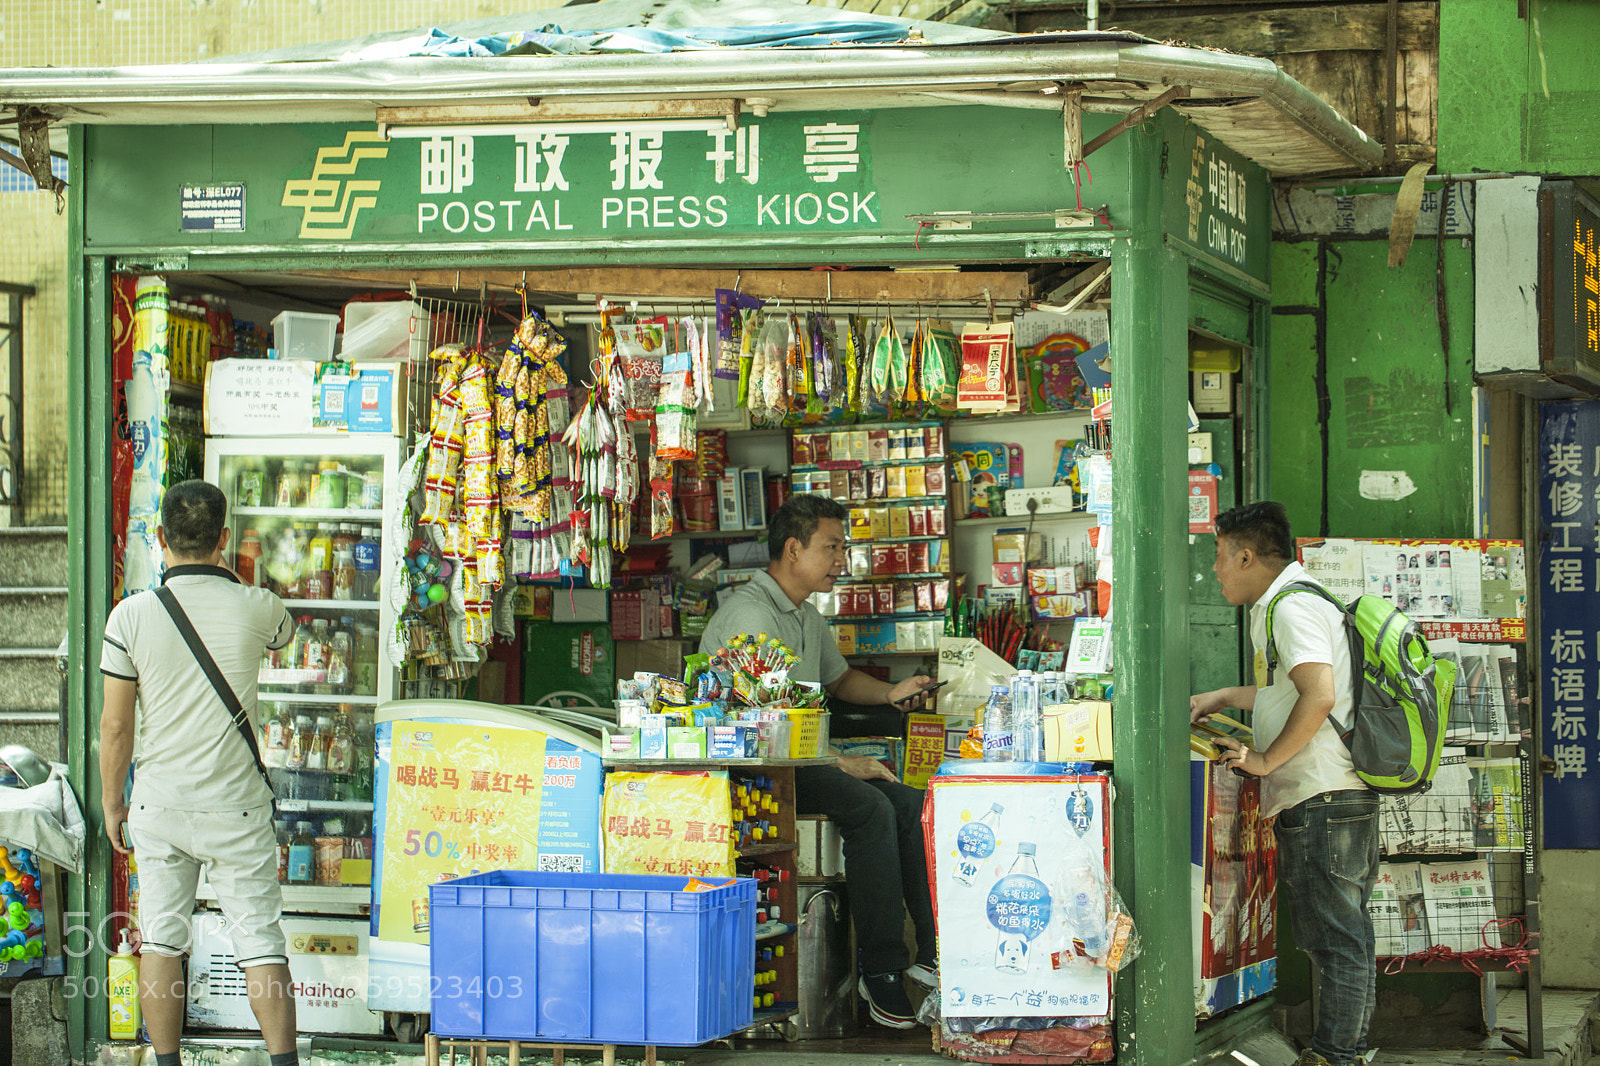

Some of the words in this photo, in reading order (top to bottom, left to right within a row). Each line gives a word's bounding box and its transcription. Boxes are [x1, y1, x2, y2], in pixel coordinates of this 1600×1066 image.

[421, 123, 860, 194] 邮政报刊亭
[1208, 152, 1246, 224] 中国邮政
[418, 200, 573, 233] POSTAL
[602, 195, 728, 229] PRESS
[757, 191, 878, 226] KIOSK
[1208, 214, 1228, 255] CHINA
[1231, 228, 1246, 266] POST
[1549, 443, 1586, 593] 装修工程
[583, 634, 592, 673] TSINGTAO
[1550, 629, 1589, 779] 标语标牌
[397, 765, 460, 791] 喝战马
[471, 770, 535, 796] 赢红牛
[403, 829, 460, 860] 50%
[466, 843, 519, 863] 中奖率
[608, 815, 674, 841] 喝战马
[114, 986, 131, 996] AXE
[292, 982, 356, 999] Haihao
